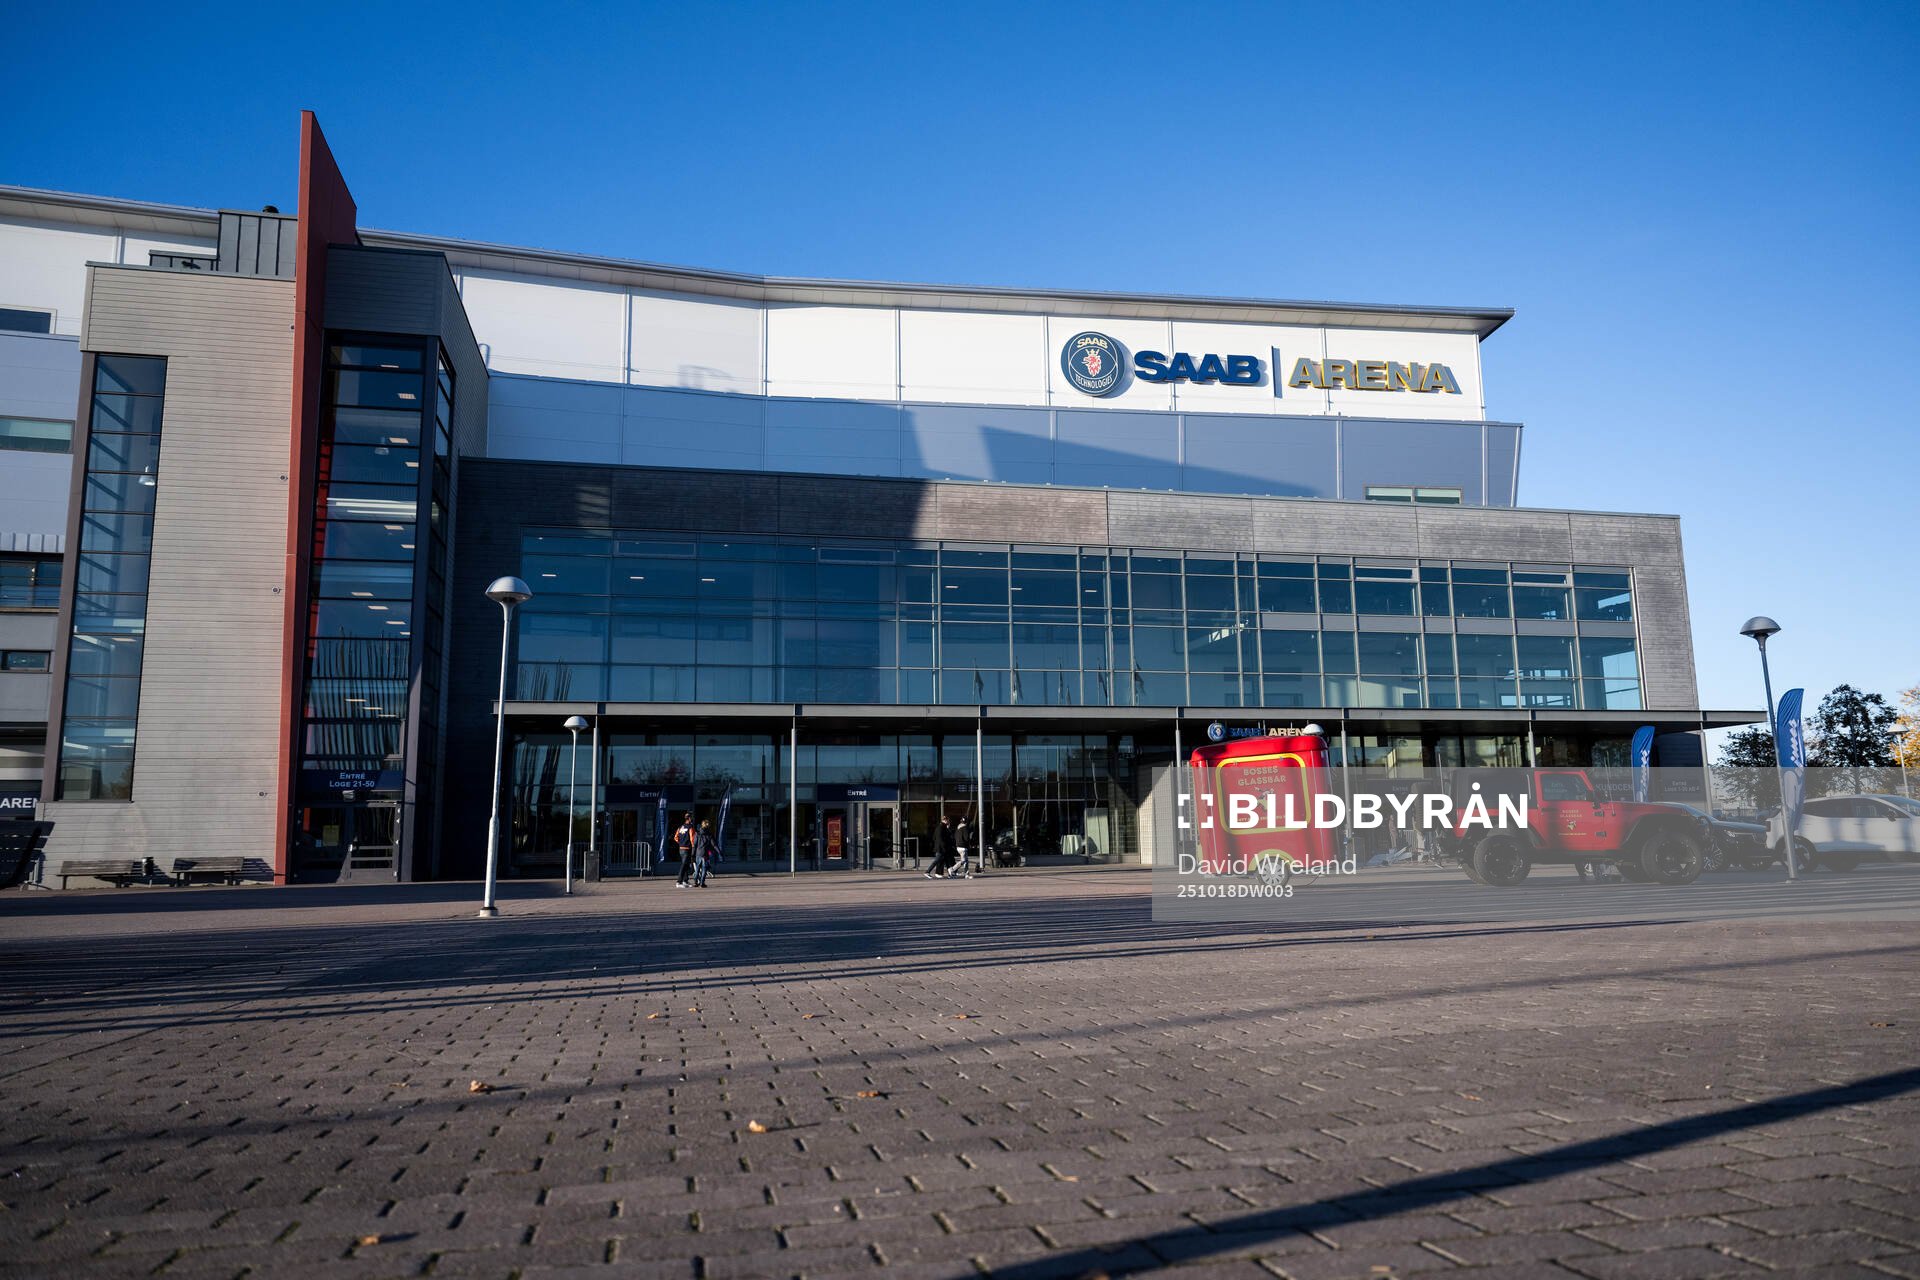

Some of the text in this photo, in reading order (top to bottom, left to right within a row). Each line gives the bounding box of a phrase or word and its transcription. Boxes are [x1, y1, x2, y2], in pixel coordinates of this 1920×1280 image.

[1076, 336, 1109, 350] SAAB
[1134, 350, 1456, 393] SAAB ARENA
[1074, 373, 1113, 389] TECHNOLOGIES
[1243, 765, 1279, 777] BOSSES
[352, 780, 375, 788] 21-50
[1237, 775, 1287, 787] GLASSBAR
